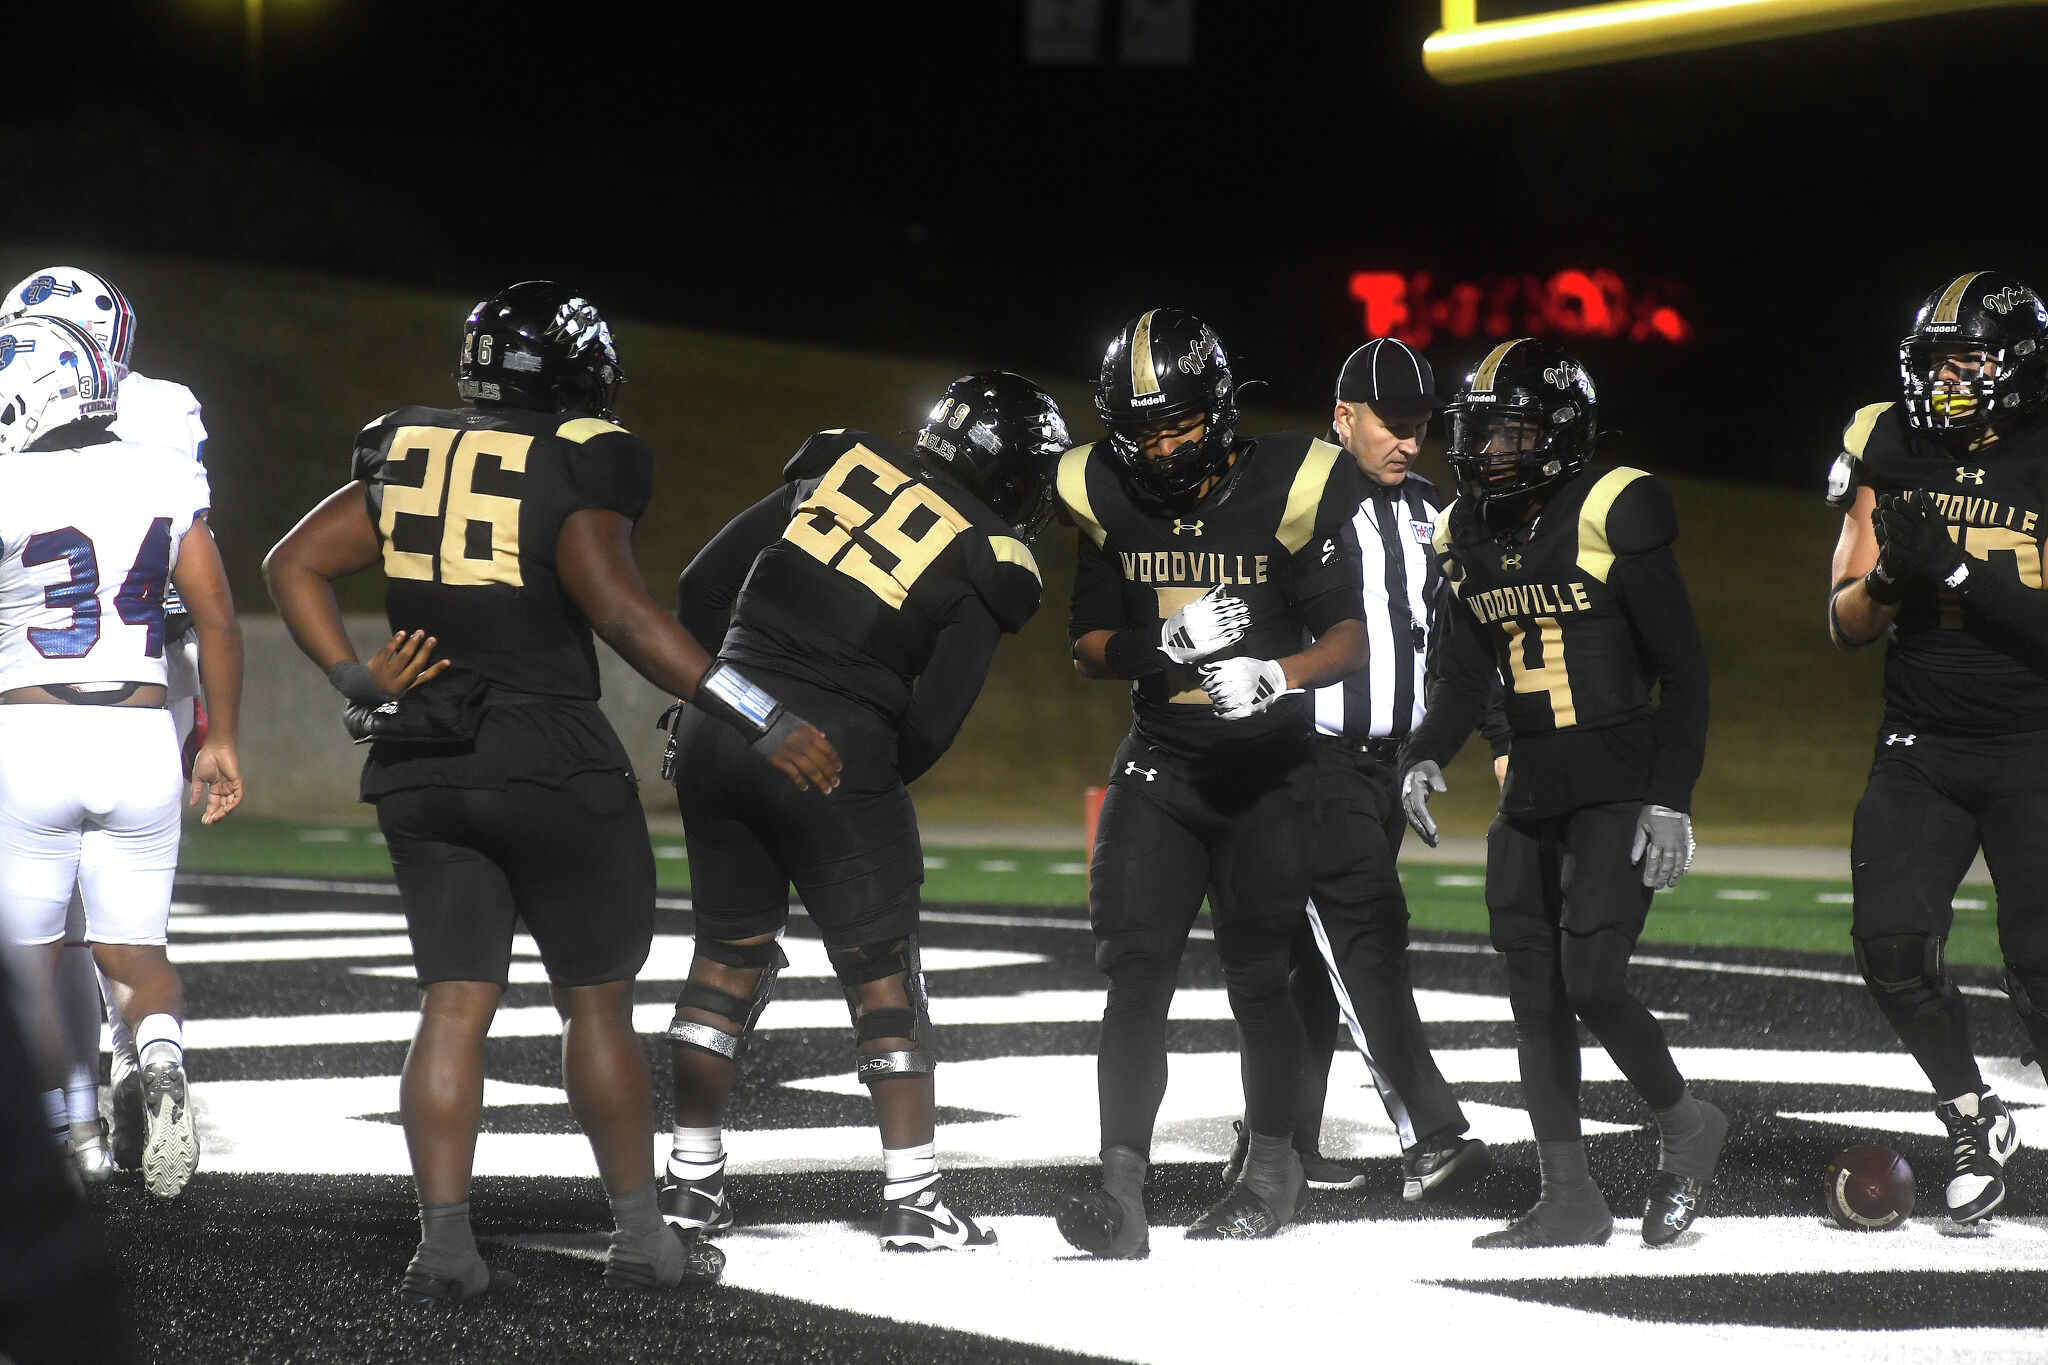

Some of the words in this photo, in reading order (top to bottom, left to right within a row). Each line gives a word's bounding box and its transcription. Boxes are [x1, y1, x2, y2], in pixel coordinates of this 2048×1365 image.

[460, 380, 501, 401] GLES
[1130, 394, 1166, 408] Riddell
[378, 426, 535, 587] 26
[781, 442, 974, 611] 69
[21, 517, 173, 660] 34
[1118, 551, 1269, 585] WOODVILLE
[1466, 582, 1592, 625] WOODVILLE
[1501, 616, 1578, 730] 4
